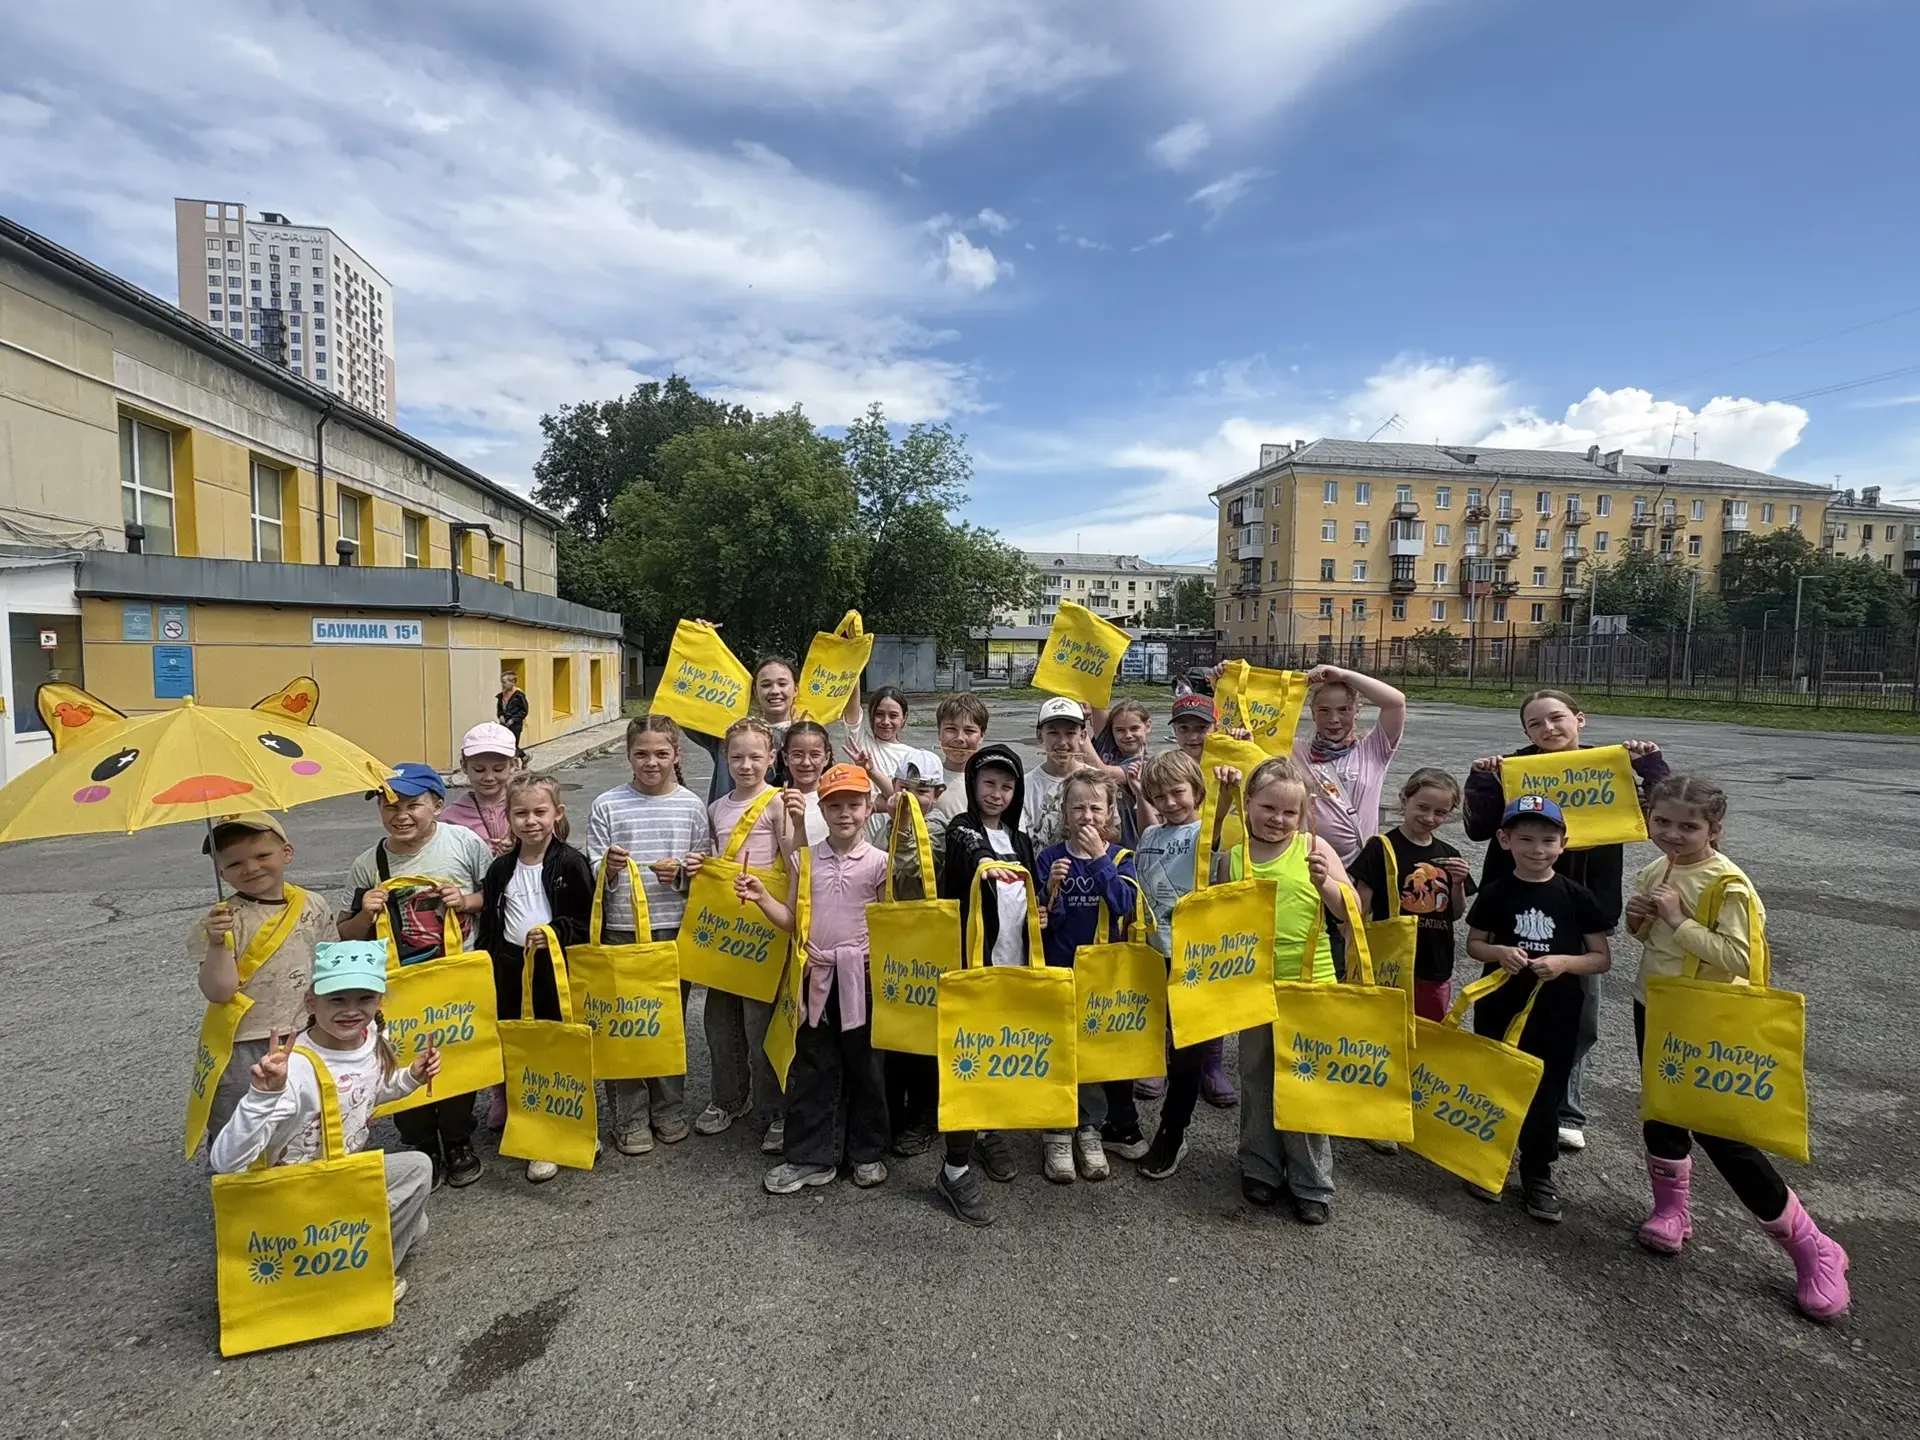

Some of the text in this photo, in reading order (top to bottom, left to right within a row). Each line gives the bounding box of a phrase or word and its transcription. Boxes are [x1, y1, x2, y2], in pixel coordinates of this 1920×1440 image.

[271, 231, 323, 244] FORUM
[316, 622, 388, 639] БАУМАНА
[1058, 633, 1082, 654] Акро
[678, 660, 706, 682] Акро
[812, 663, 838, 684] Акро
[1071, 656, 1105, 678] 2026
[695, 684, 738, 709] 2026
[1222, 696, 1241, 717] Акр
[1521, 772, 1560, 793] Акро
[1556, 780, 1616, 808] 2026
[697, 906, 730, 933] Акро
[718, 935, 769, 963] 2026
[1184, 940, 1217, 965] Акро
[883, 953, 909, 983] Акро
[1208, 947, 1257, 981] 2026
[583, 991, 613, 1018] Акро
[904, 983, 938, 1008] 202
[1086, 990, 1113, 1015] Акро
[387, 1017, 418, 1039] кро
[608, 1010, 661, 1038] 2026
[1105, 1006, 1147, 1033] 2026
[413, 1014, 475, 1053] 2026
[953, 1027, 995, 1056] Акро
[1292, 1031, 1334, 1061] Акро
[1662, 1031, 1702, 1063] Акро
[987, 1047, 1051, 1078] 2026
[1326, 1059, 1389, 1088] 2026
[523, 1065, 550, 1095] Акро
[1411, 1062, 1451, 1096] Акро
[1693, 1065, 1774, 1102] 2026
[545, 1094, 584, 1120] 2026
[1432, 1100, 1500, 1142] 2026
[248, 1230, 298, 1259] Акро
[292, 1236, 369, 1277] 2026
